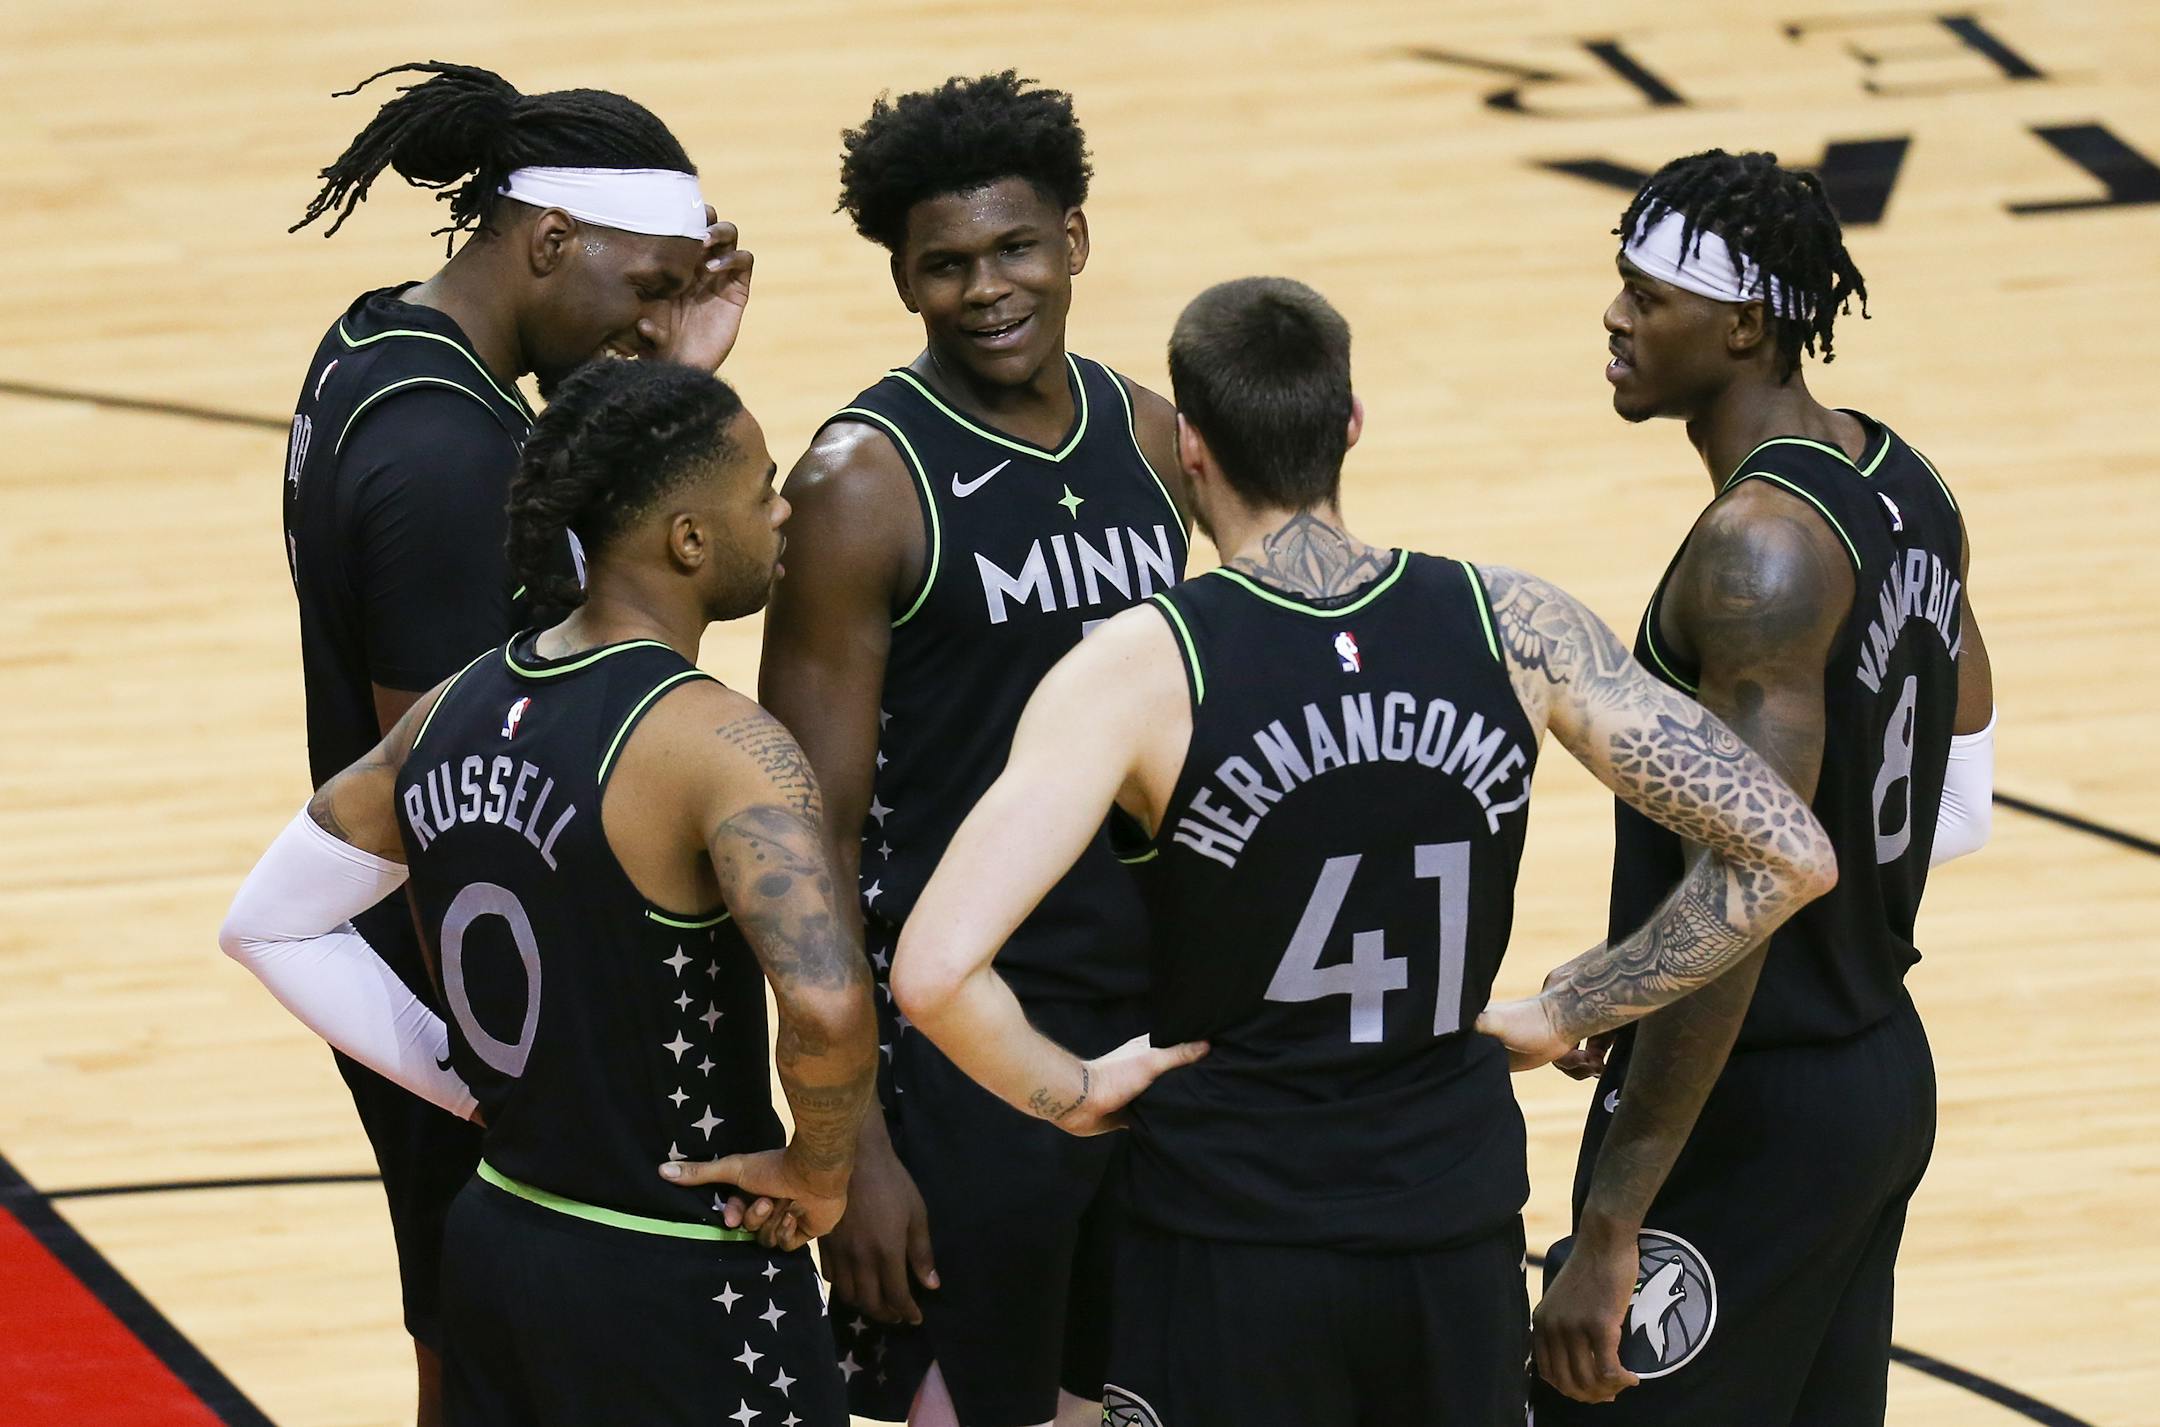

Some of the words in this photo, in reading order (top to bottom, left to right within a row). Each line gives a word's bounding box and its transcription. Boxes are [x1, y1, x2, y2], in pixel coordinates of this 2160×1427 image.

[974, 525, 1176, 624] MINN
[404, 754, 577, 872] RUSSELL
[1173, 691, 1530, 869] HERNANGOMEZ
[1872, 674, 1918, 865] 8
[440, 881, 542, 1079] 0
[1263, 840, 1471, 1043] 41
